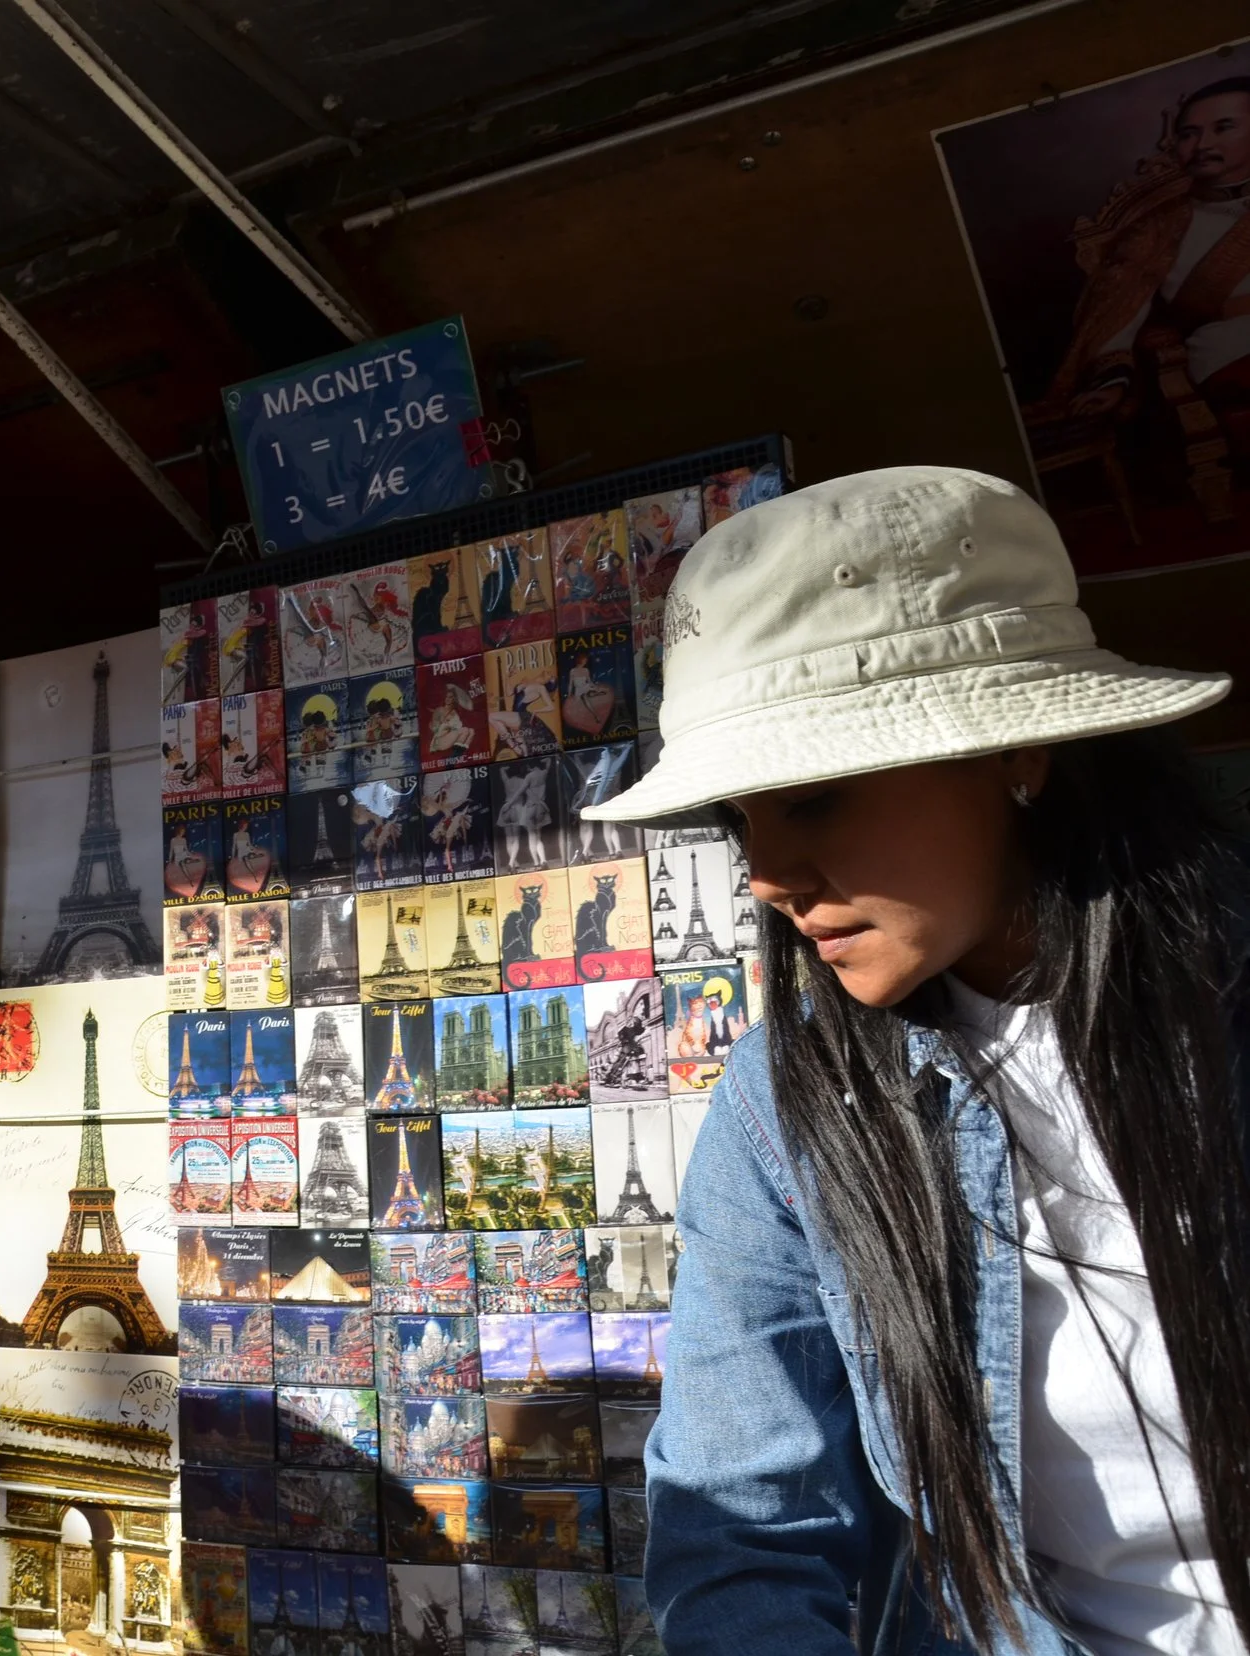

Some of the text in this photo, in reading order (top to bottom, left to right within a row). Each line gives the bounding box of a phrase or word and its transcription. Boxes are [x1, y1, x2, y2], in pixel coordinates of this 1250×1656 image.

[263, 348, 418, 419] MAGNETS
[271, 394, 450, 467] 1 = 1.50€
[285, 466, 409, 524] 3 = 4€
[356, 566, 407, 580] MOULIN ROUGE
[219, 593, 250, 622] Paris
[161, 606, 191, 634] Paris
[506, 642, 555, 673] PARIS
[385, 667, 414, 680] PARIS
[432, 659, 467, 677] PARIS
[321, 681, 348, 694] PARIS
[223, 696, 247, 712] PARIS
[163, 704, 186, 720] PARIS
[163, 795, 182, 805] VILLE
[182, 794, 192, 802] DE
[223, 789, 243, 799] VILLE
[244, 788, 253, 796] DE
[442, 872, 454, 882] DES
[163, 891, 225, 906] VILLE D'AMOUR
[226, 886, 291, 904] VILLE D'AMOUR
[166, 963, 200, 974] MOULIN ROUGE
[227, 961, 262, 973] MOULIN ROUGE
[664, 971, 704, 985] PARIS
[370, 1006, 392, 1017] Tour
[400, 1004, 427, 1017] Eiffel
[196, 1020, 226, 1034] Paris
[258, 1016, 290, 1030] Paris
[568, 1097, 588, 1106] Paris
[169, 1124, 229, 1136] EXPOSITION UNIVERSELLE
[232, 1122, 295, 1134] EXPOSITION UNIVERSELLE
[374, 1122, 397, 1134] Tour
[406, 1119, 432, 1133] Eiffel
[212, 1231, 240, 1240] Champs
[227, 1241, 250, 1251] Paris
[232, 1252, 265, 1262] décembre
